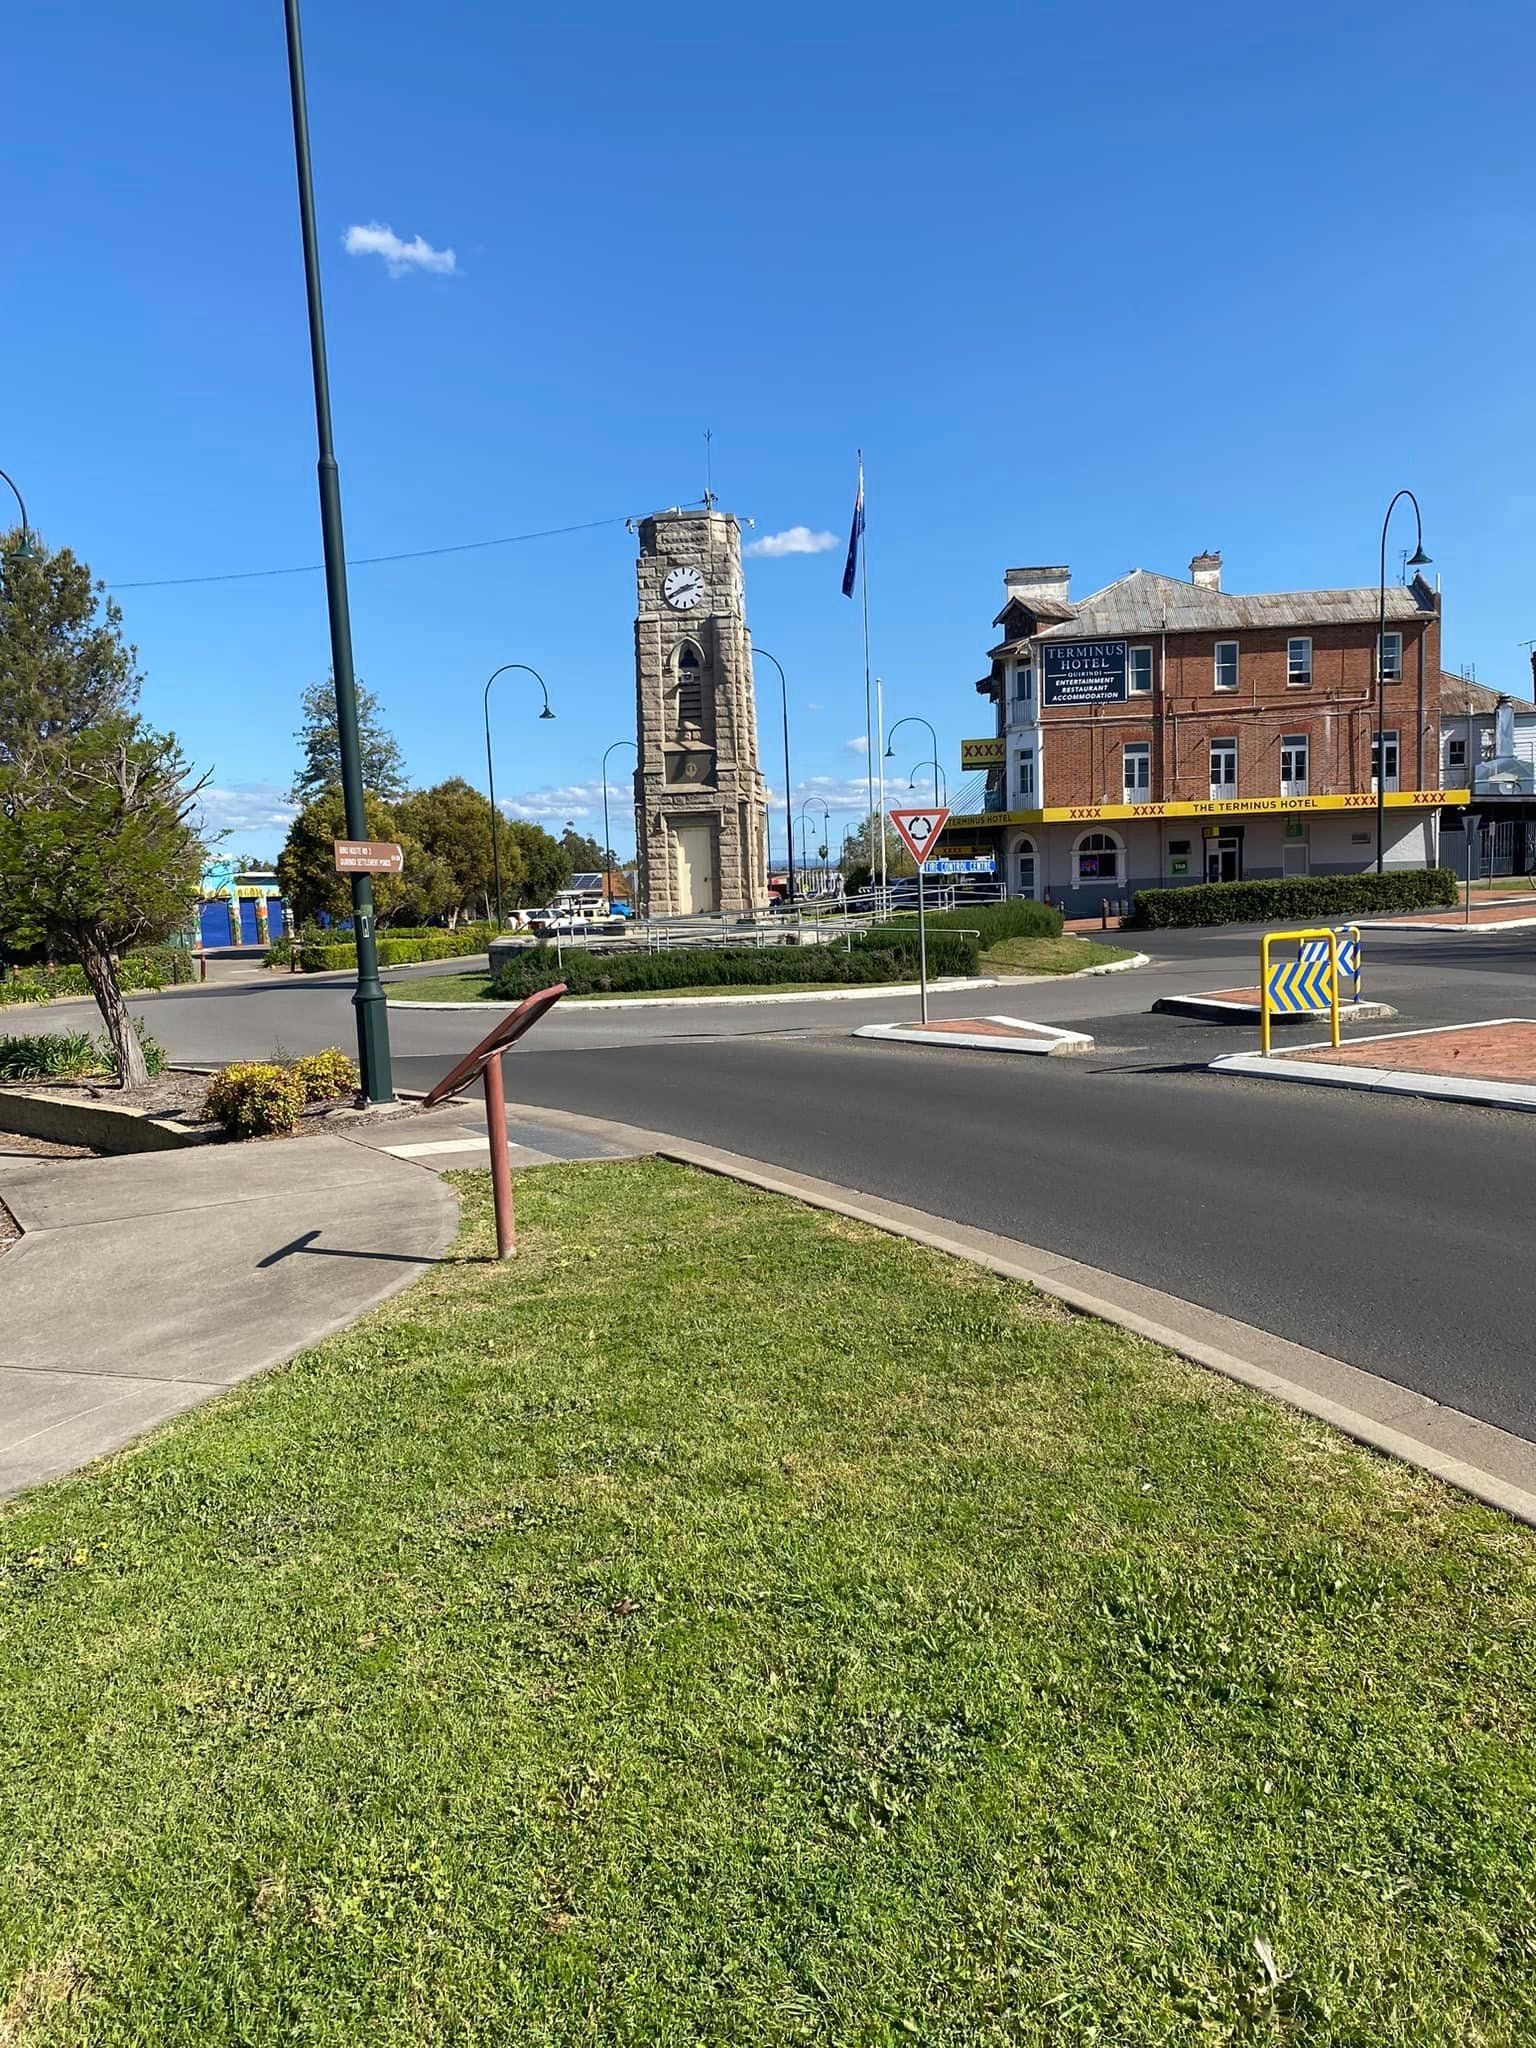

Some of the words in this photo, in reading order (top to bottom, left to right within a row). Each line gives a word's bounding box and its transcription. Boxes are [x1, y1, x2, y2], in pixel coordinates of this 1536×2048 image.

[1048, 645, 1123, 659] TERMINUS
[1061, 658, 1110, 670] HOTEL
[1067, 670, 1102, 678] QUIRINDI
[1056, 677, 1115, 686] ENTERTAINMENT
[1062, 685, 1108, 693] RESTAURANT
[1052, 692, 1119, 702] ACCOMMODATION
[964, 743, 1004, 758] XXXX
[1344, 795, 1377, 807] XXXX
[1413, 793, 1447, 803] XXXX
[1133, 805, 1165, 816] XXXX
[1193, 803, 1215, 813] THE
[1218, 800, 1277, 812] TERMINUS
[1280, 798, 1318, 809] HOTEL
[987, 814, 1012, 824] HOTEL
[1070, 808, 1102, 819] XXXX
